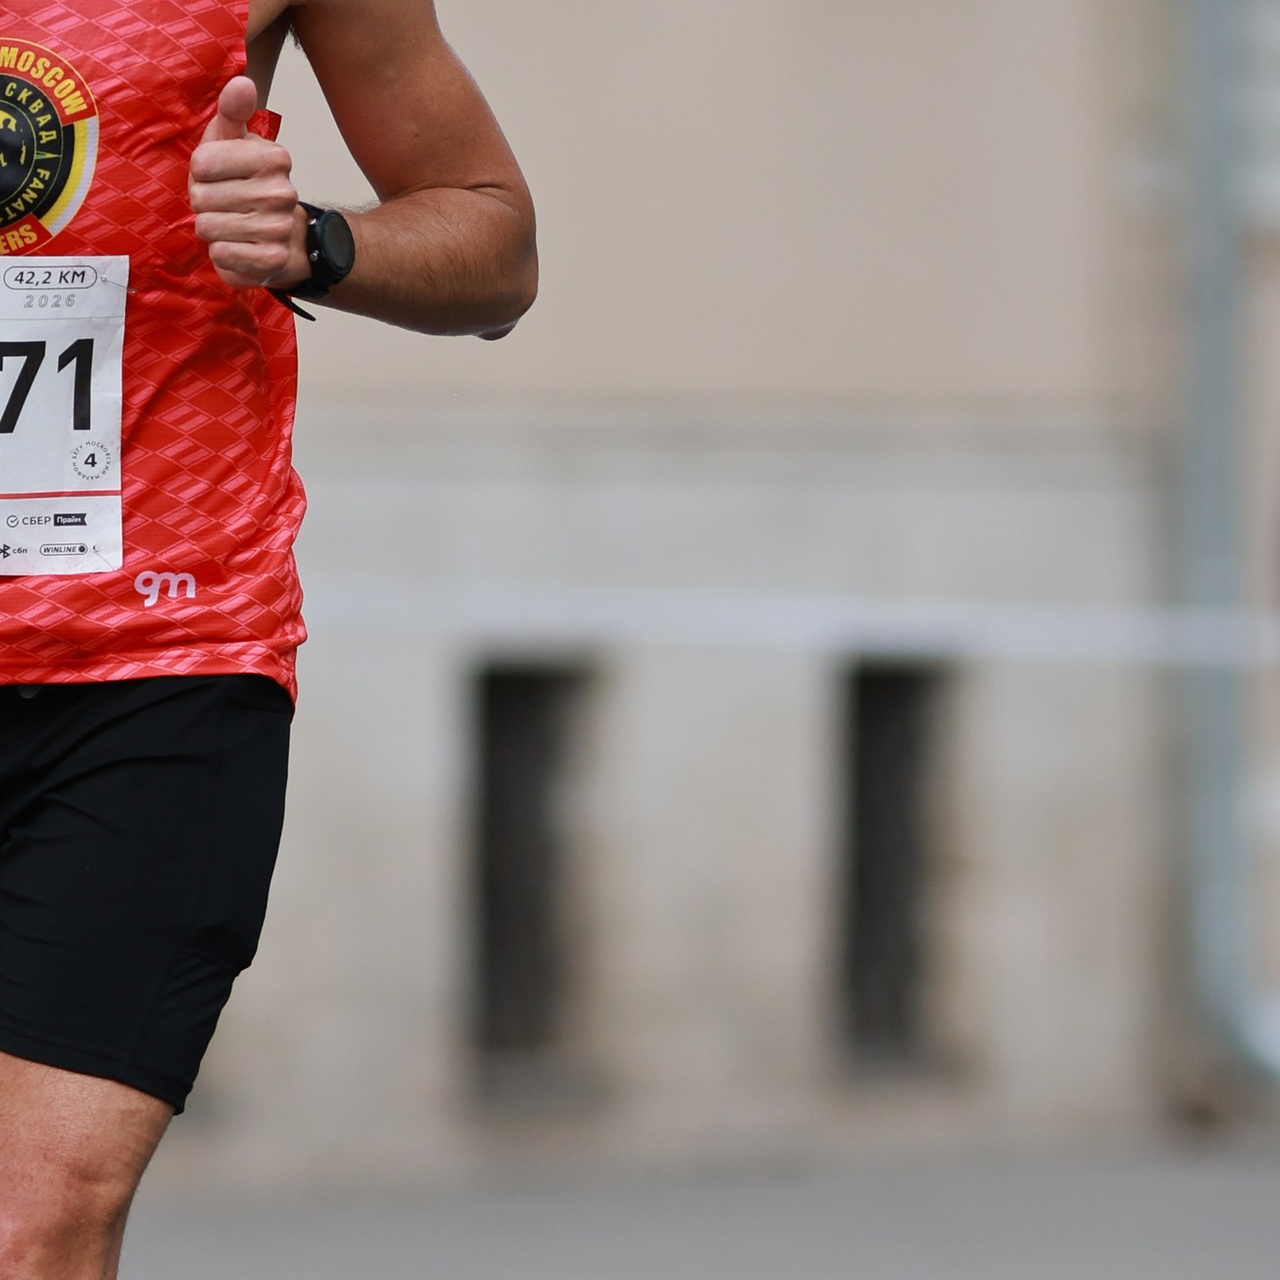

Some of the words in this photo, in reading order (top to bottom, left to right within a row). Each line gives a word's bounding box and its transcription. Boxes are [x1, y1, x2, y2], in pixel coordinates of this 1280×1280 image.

[5, 82, 57, 144] СКВАД
[14, 271, 52, 286] 42,2
[23, 294, 76, 308] 2026
[84, 452, 98, 468] 4
[22, 516, 51, 526] СБЕР
[12, 546, 28, 554] сбп
[43, 545, 77, 553] WINLINE
